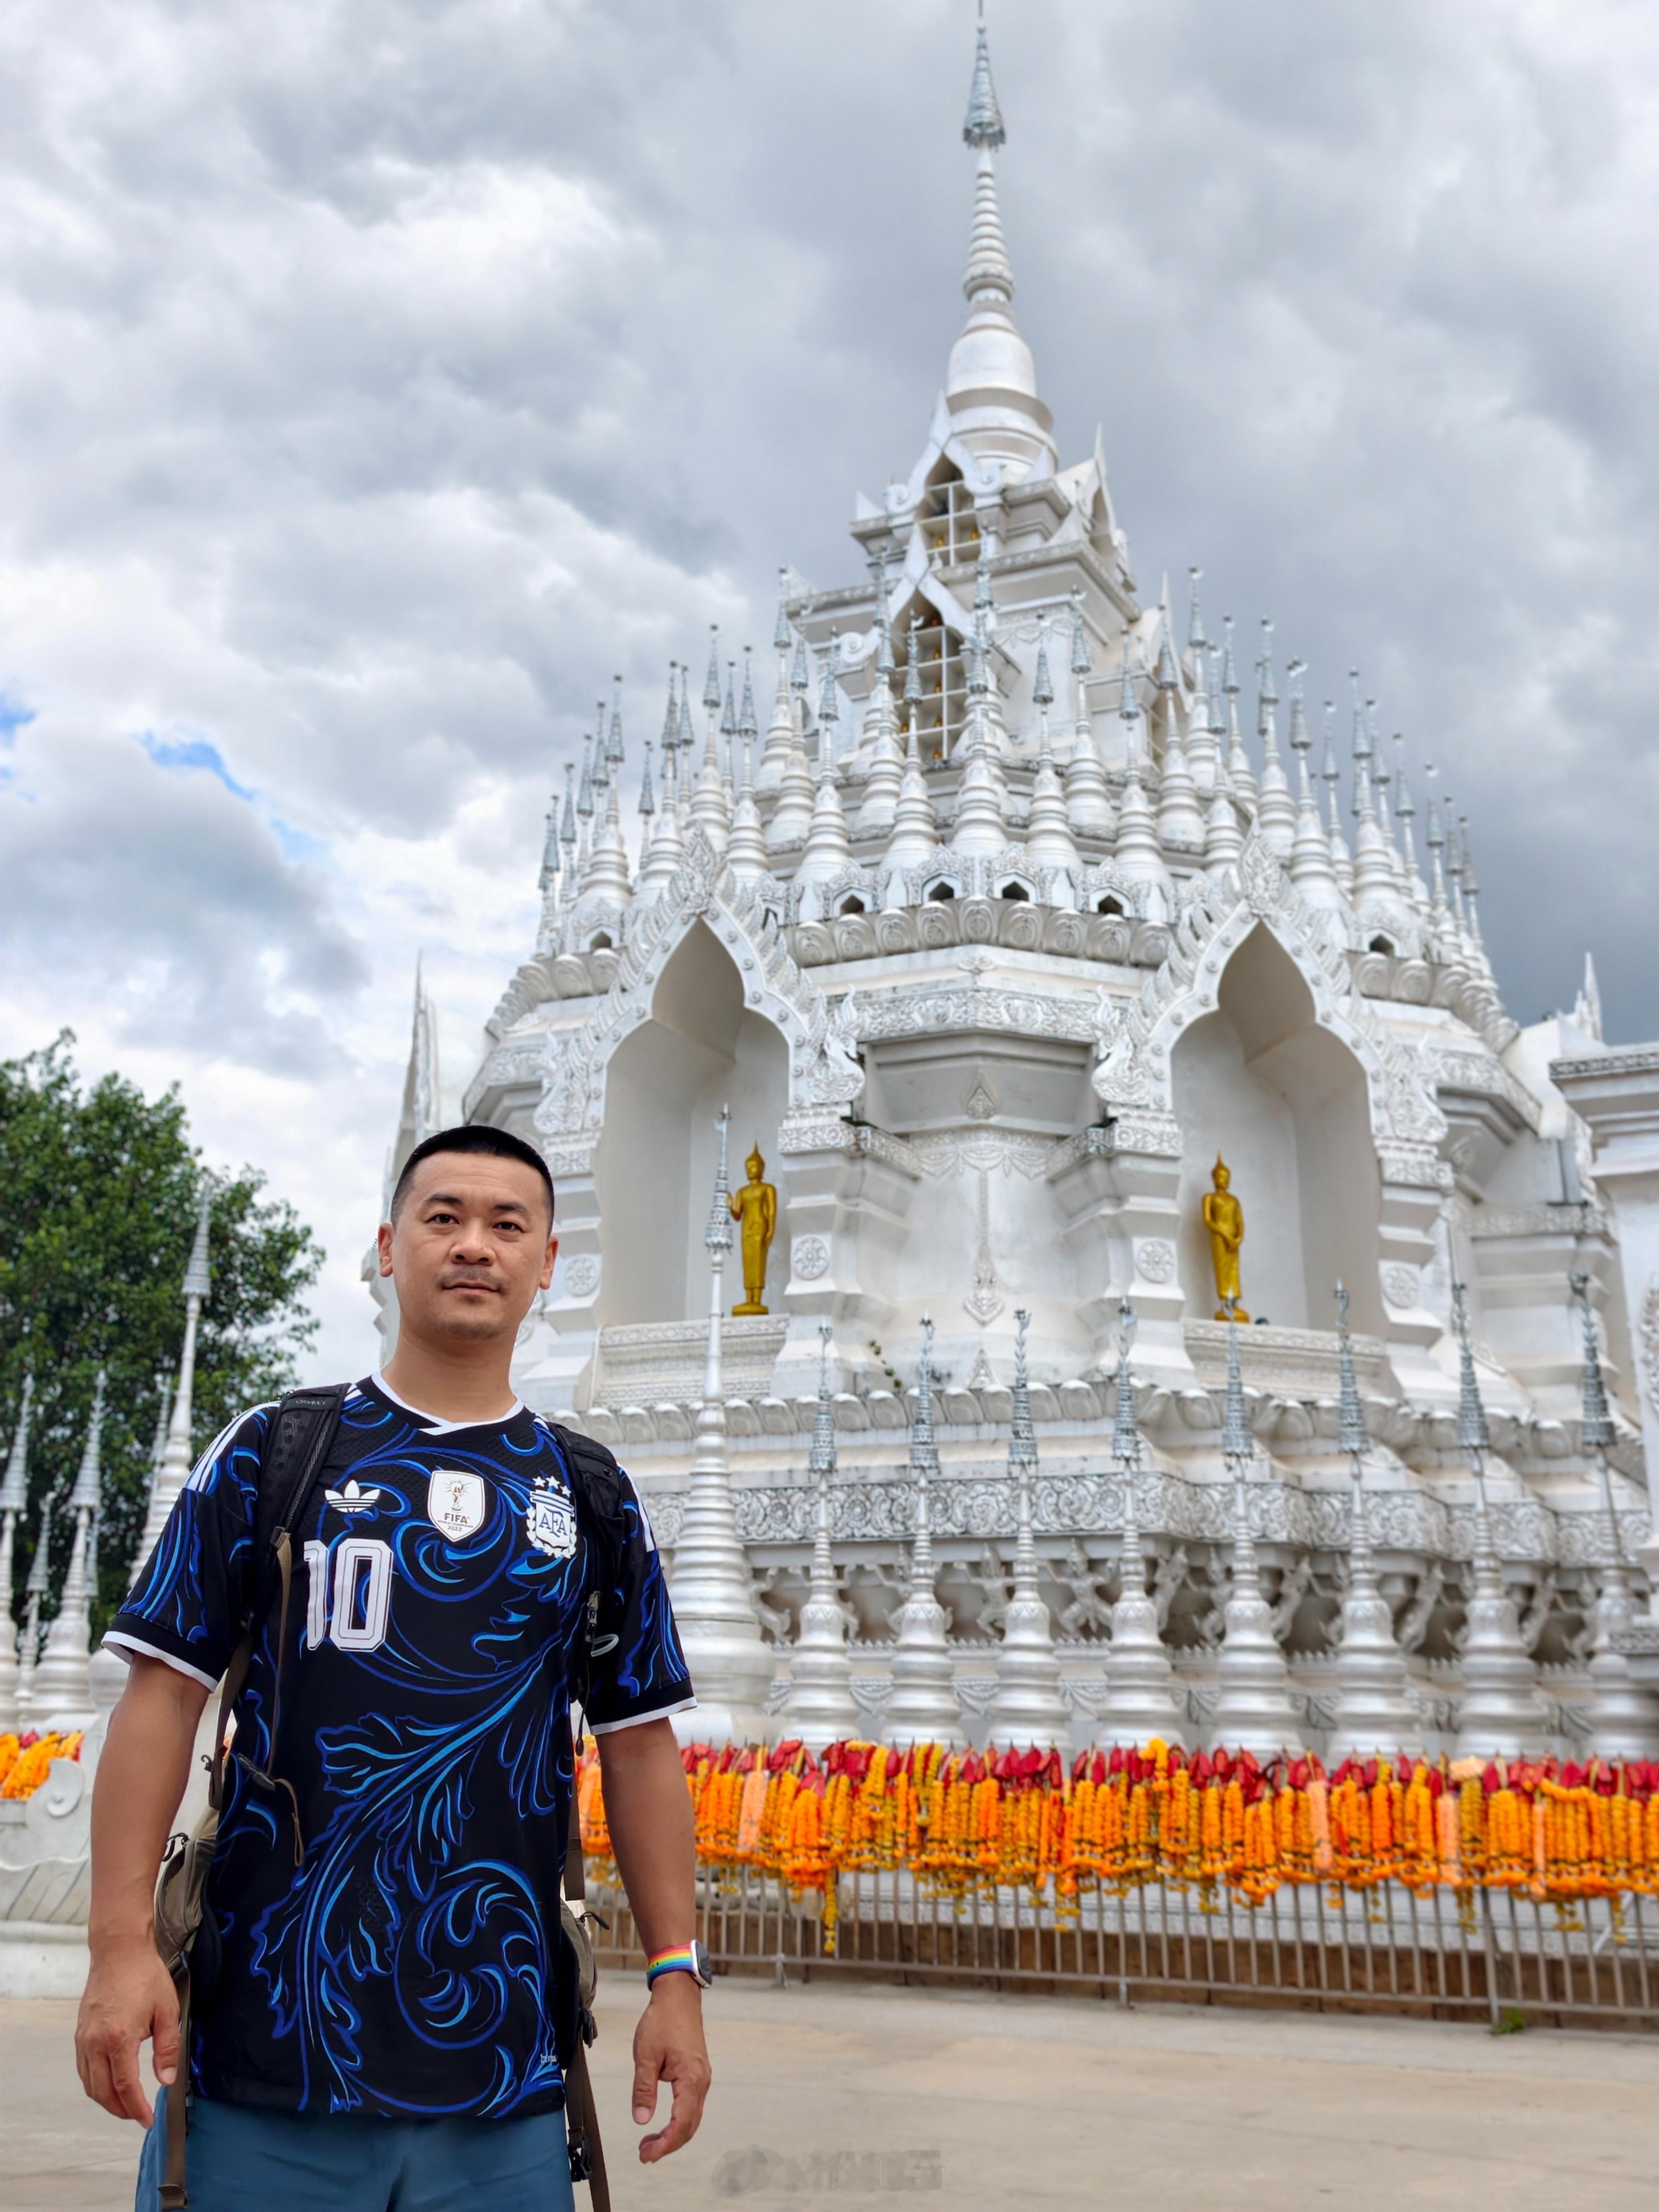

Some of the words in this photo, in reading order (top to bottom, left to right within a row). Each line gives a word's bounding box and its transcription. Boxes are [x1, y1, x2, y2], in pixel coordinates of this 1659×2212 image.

[444, 1513, 468, 1524] FIFA
[538, 1505, 567, 1537] AFA
[304, 1538, 394, 1652] 10
